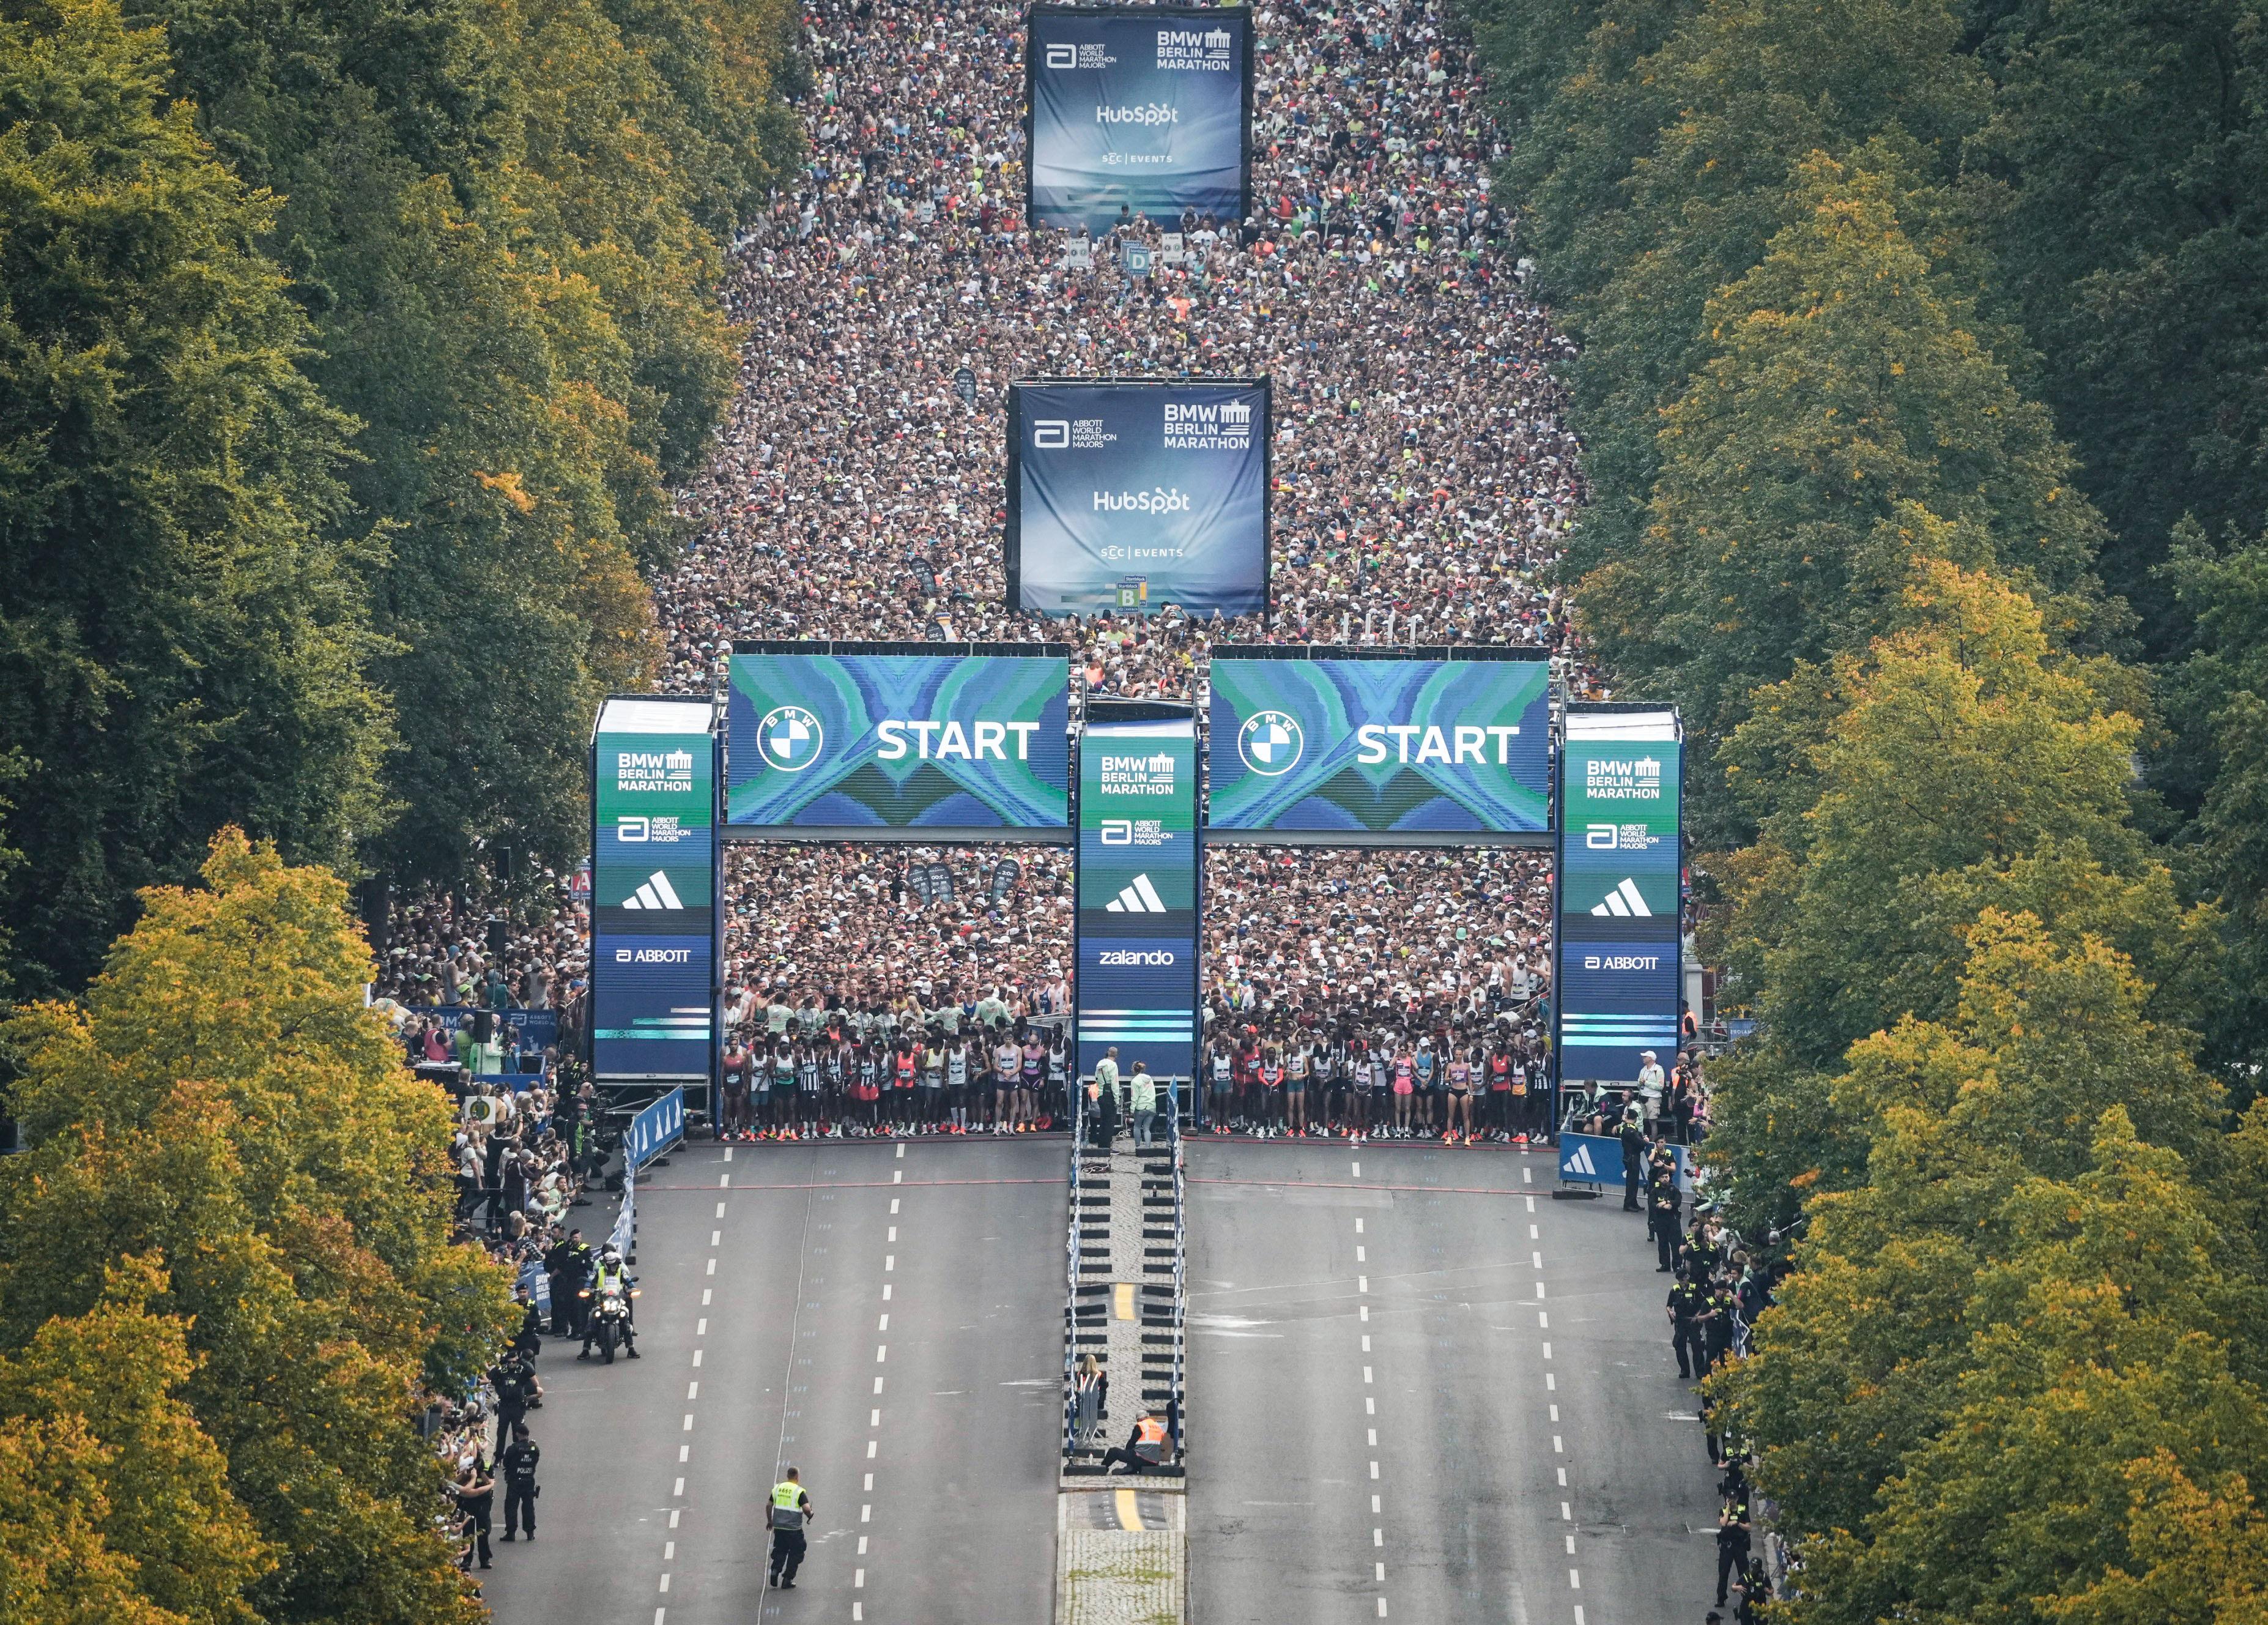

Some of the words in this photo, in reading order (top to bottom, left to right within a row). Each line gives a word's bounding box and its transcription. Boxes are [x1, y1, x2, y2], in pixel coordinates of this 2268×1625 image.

[1158, 31, 1203, 46] BMW
[1158, 47, 1203, 58] BERLIN
[1157, 59, 1229, 71] MARATHON
[1097, 103, 1178, 125] HubSpot
[1133, 254, 1145, 269] D
[1165, 404, 1217, 422] BMW
[1165, 423, 1217, 434] BERLIN
[1165, 437, 1249, 448] MARATHON
[1094, 488, 1190, 514] HubSpot
[1122, 590, 1134, 606] B
[766, 709, 814, 727] BMW
[1248, 714, 1294, 732] BMW
[878, 720, 1039, 759] START
[1358, 724, 1519, 764] START
[619, 754, 664, 768] BMW
[1102, 757, 1146, 771] BMW
[1588, 761, 1632, 775] BMW
[619, 769, 664, 779] BERLIN
[1102, 773, 1147, 782] BERLIN
[618, 781, 691, 791] MARATHON
[1587, 777, 1632, 786] BERLIN
[1102, 784, 1173, 794] MARATHON
[1587, 788, 1659, 798] MARATHON
[635, 950, 691, 962] ABBOTT
[1100, 951, 1174, 965] zalando
[1604, 957, 1659, 969] ABBOTT
